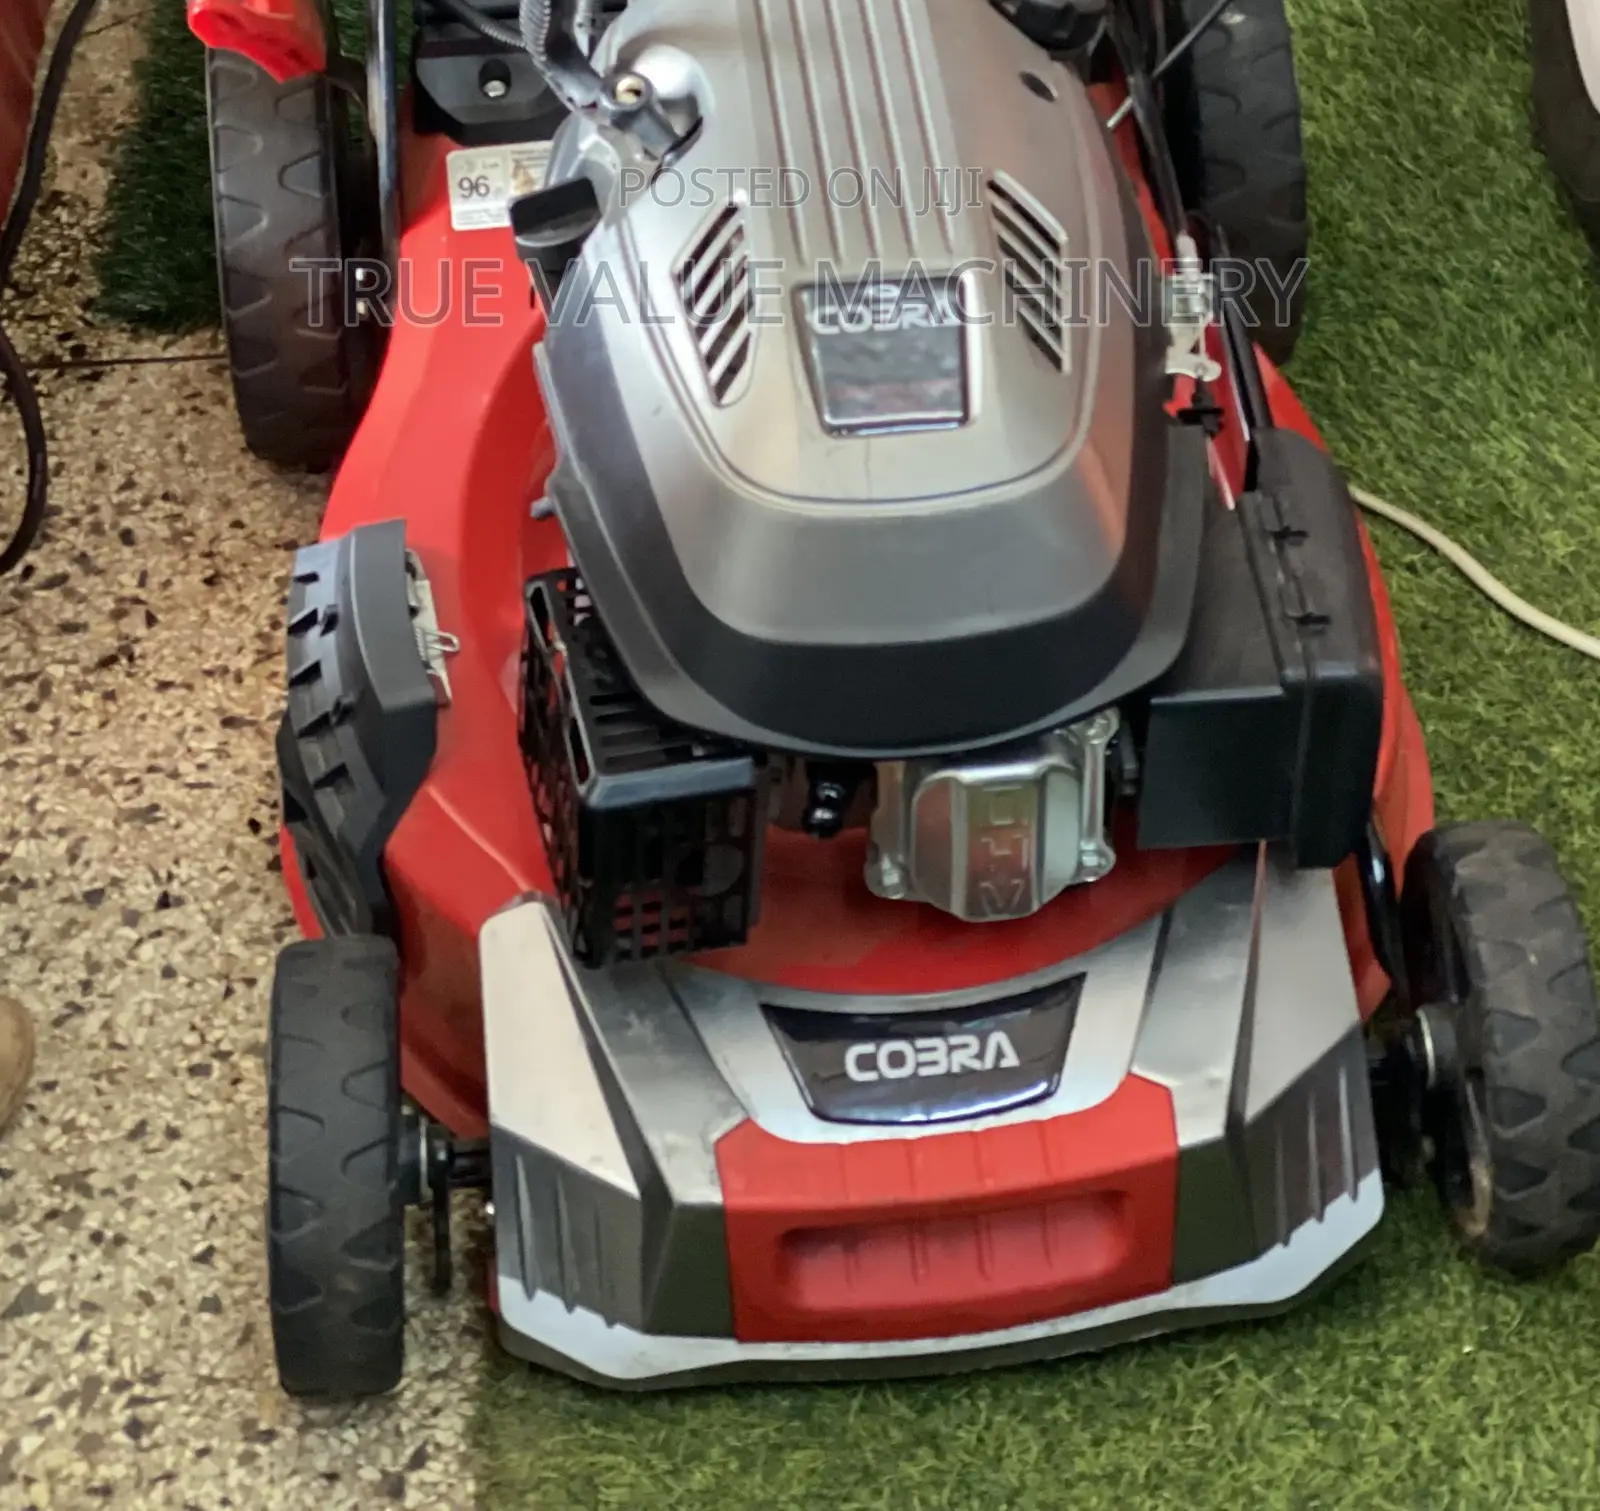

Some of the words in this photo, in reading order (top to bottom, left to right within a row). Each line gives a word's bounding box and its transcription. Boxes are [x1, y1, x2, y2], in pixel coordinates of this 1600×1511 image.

[458, 175, 491, 199] 96
[811, 300, 962, 336] COBRA
[844, 1030, 1021, 1082] COBRA
